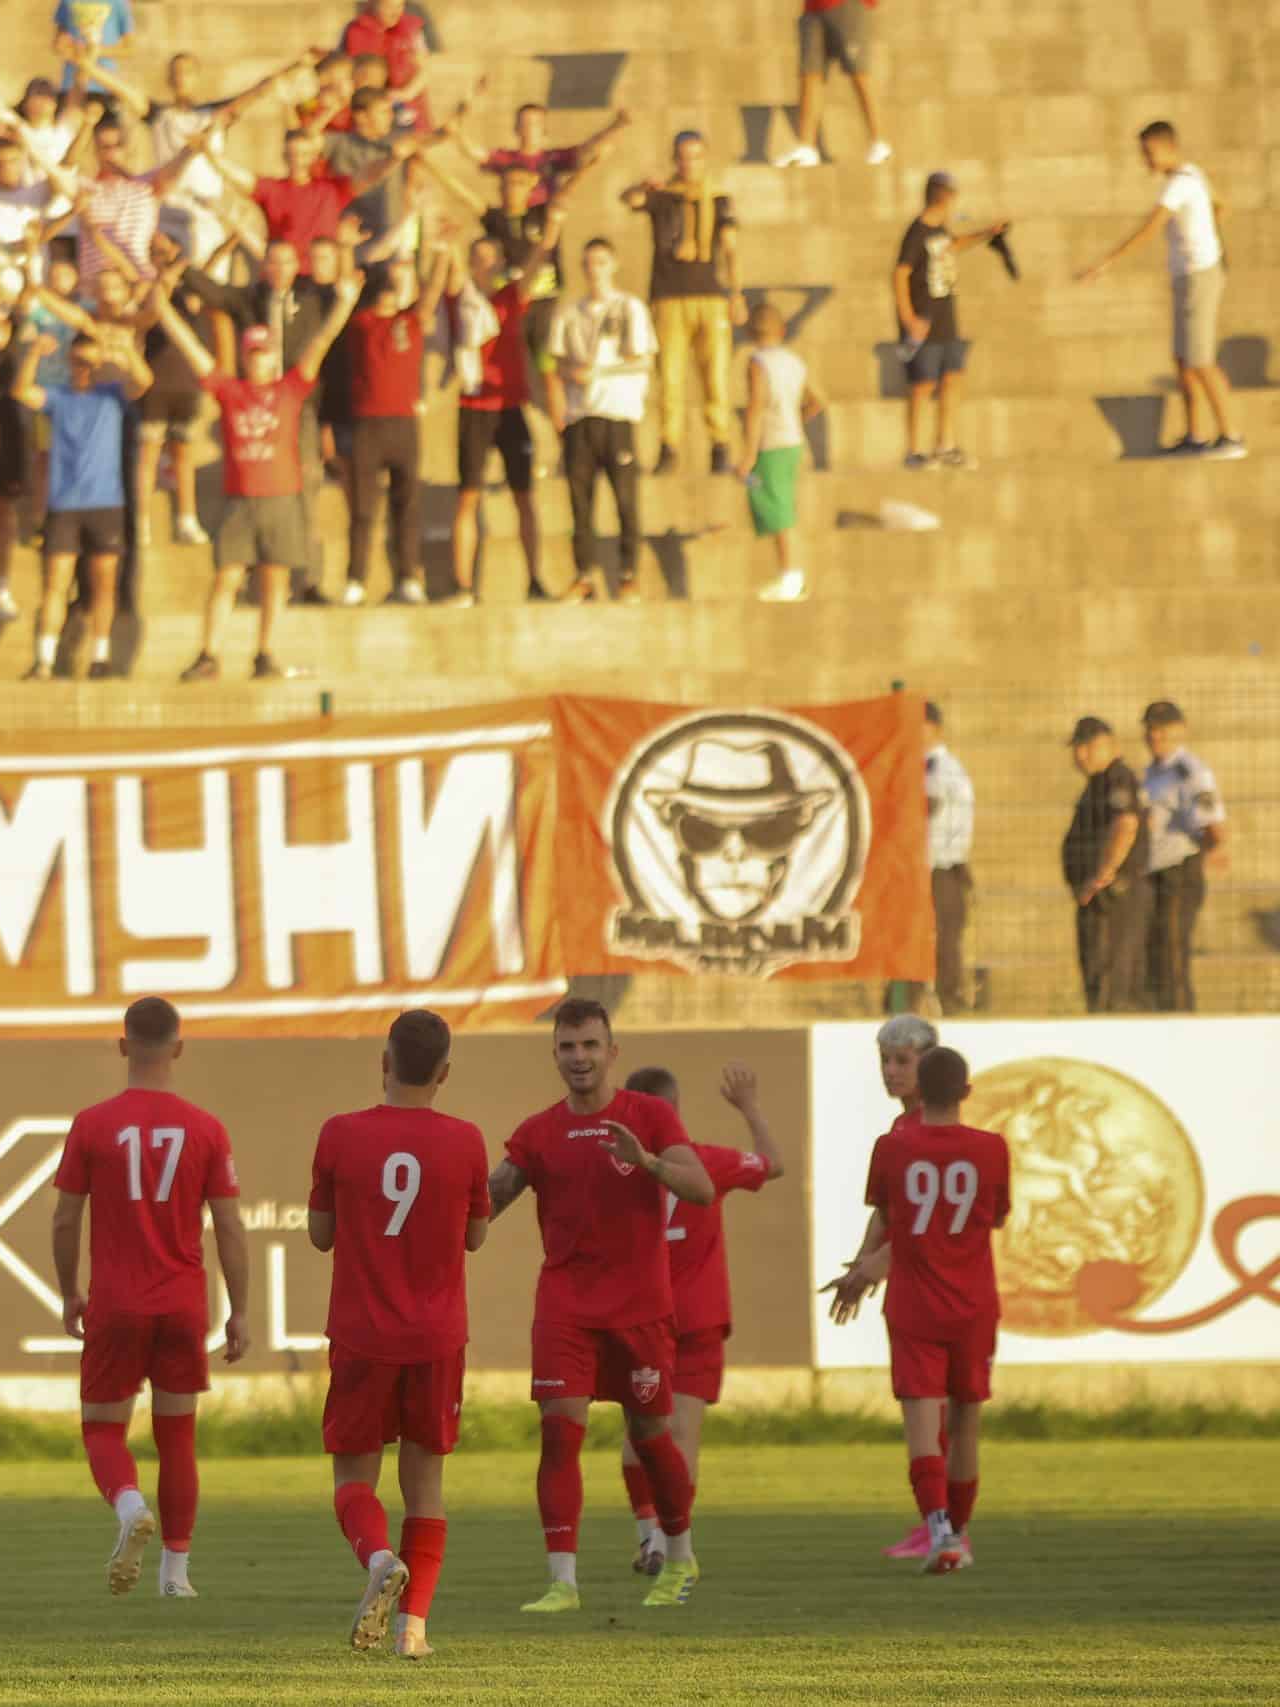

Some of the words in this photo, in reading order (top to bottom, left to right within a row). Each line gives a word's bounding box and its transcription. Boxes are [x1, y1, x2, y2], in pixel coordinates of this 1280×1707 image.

[115, 1125, 186, 1203] 17
[381, 1151, 422, 1237] 9
[904, 1160, 979, 1236] 99
